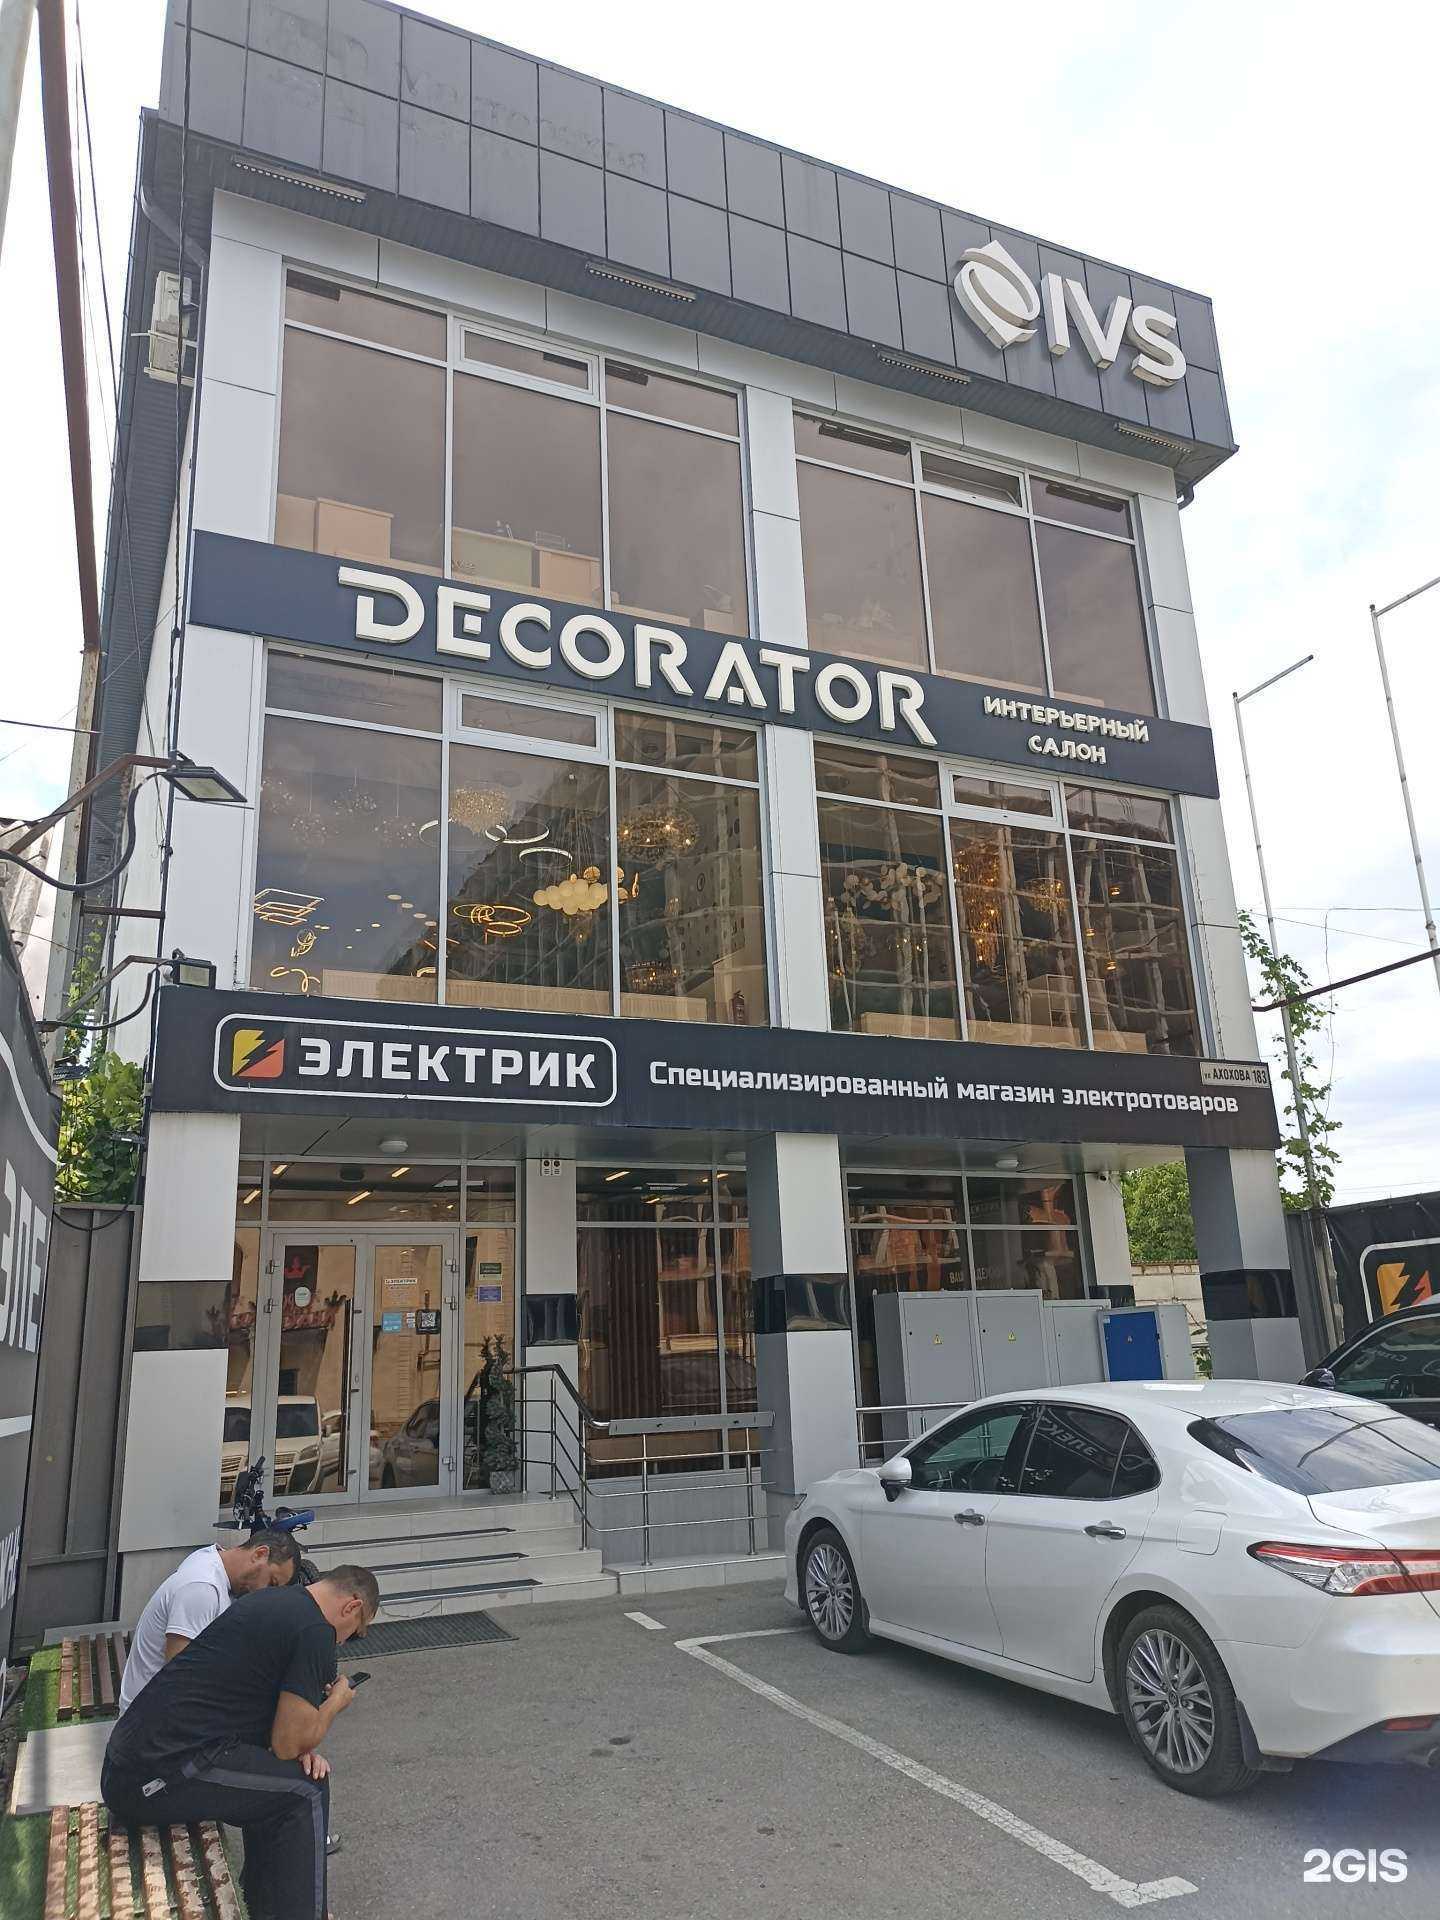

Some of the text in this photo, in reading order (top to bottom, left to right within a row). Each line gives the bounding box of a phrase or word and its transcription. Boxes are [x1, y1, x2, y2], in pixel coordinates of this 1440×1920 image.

[1041, 272, 1187, 387] IVS
[337, 565, 938, 746] DECORATOR
[983, 695, 1149, 743] ИНТЕРЬЕРНЫЙ
[1028, 734, 1107, 764] САЛОН
[297, 1038, 596, 1089] ЭЛЕКТРИК
[649, 1061, 1238, 1115] Специализированный магазин электротоваров
[1213, 1068, 1251, 1081] АХОХОВА
[1252, 1069, 1268, 1084] 183
[0, 1159, 51, 1353] ЭЛЕ
